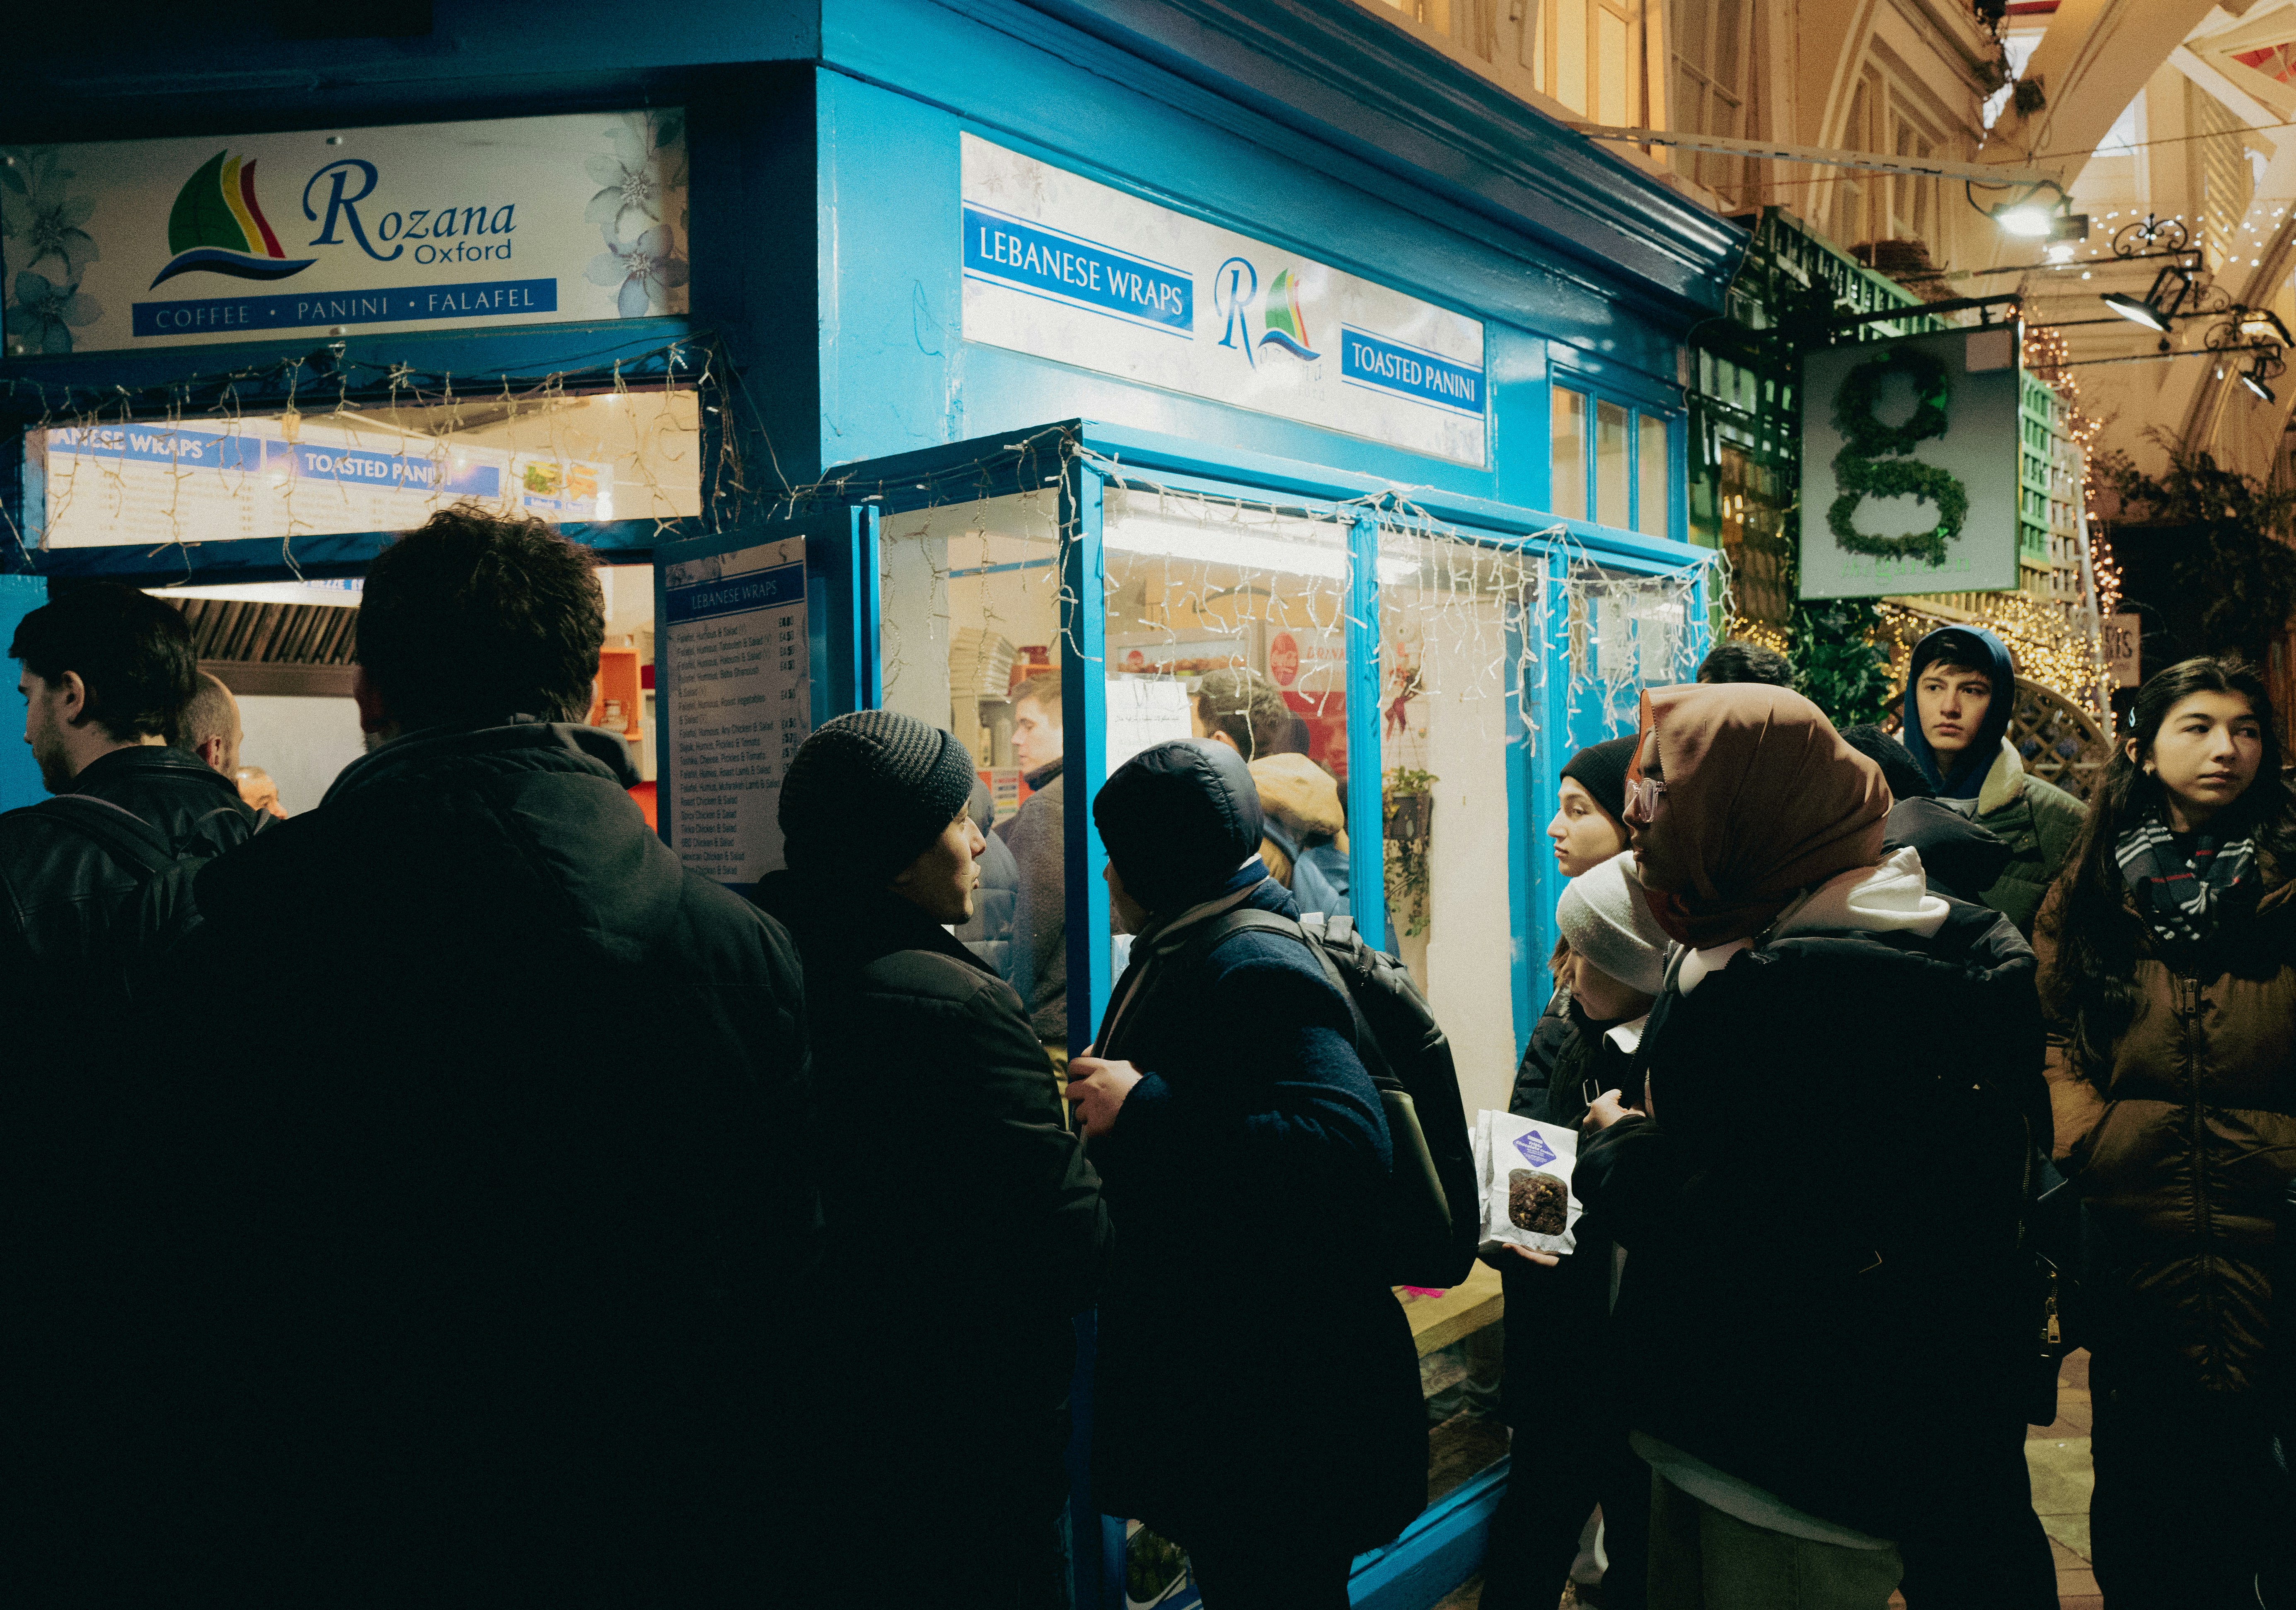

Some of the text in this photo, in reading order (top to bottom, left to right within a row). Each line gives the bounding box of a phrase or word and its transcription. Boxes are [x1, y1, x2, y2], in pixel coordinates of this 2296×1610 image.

[302, 159, 516, 262] Rozana
[414, 238, 513, 265] Oxford
[979, 225, 1183, 316] LEBANESE WRAPS
[156, 286, 535, 329] COFFEE PANINI FALAFEL
[1352, 341, 1475, 402] TOASTED PANINI
[50, 429, 203, 458] ANESE WRAPS
[305, 453, 388, 478] TOASTED
[692, 580, 778, 610] LEBANESE WRAPS
